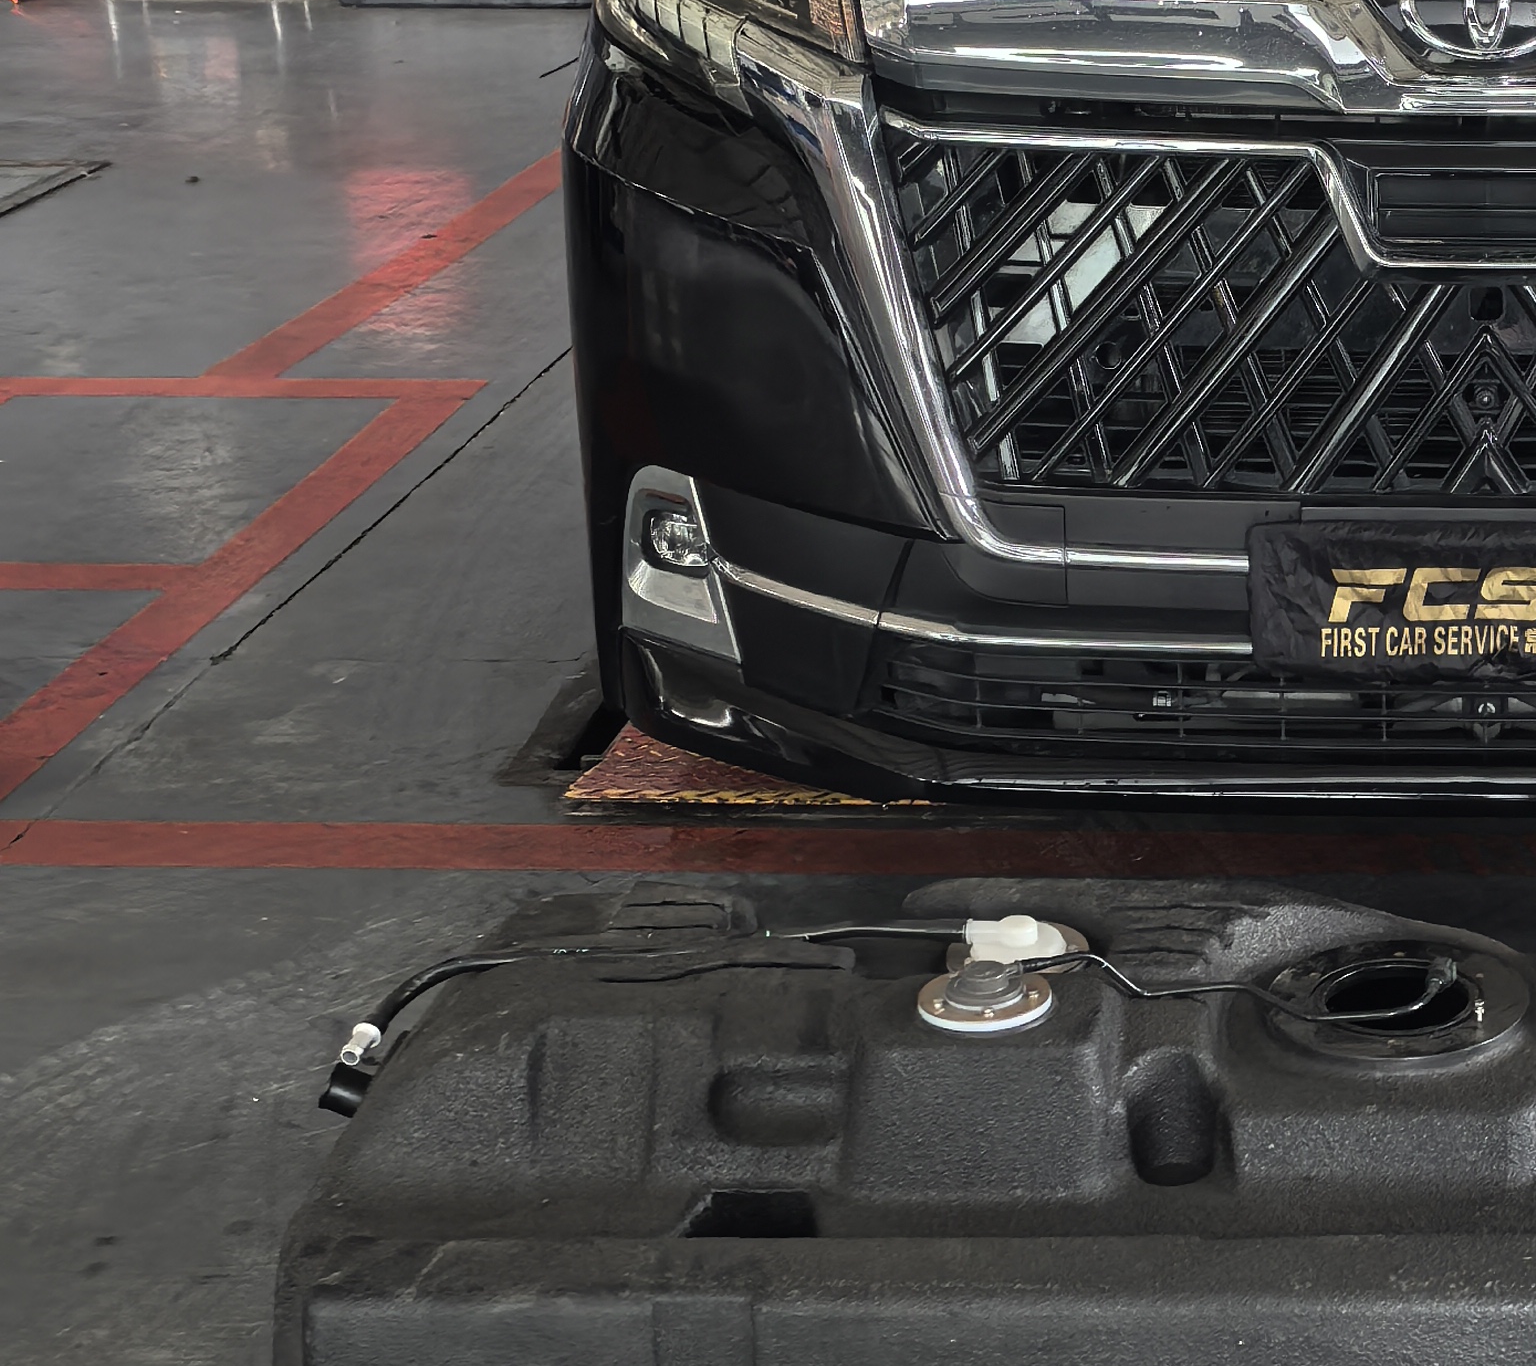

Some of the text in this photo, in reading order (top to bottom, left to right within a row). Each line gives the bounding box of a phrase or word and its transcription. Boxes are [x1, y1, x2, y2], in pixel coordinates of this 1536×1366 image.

[1320, 627, 1380, 658] FIRST
[1385, 626, 1428, 656] CAR
[1434, 624, 1519, 656] SERVICE
